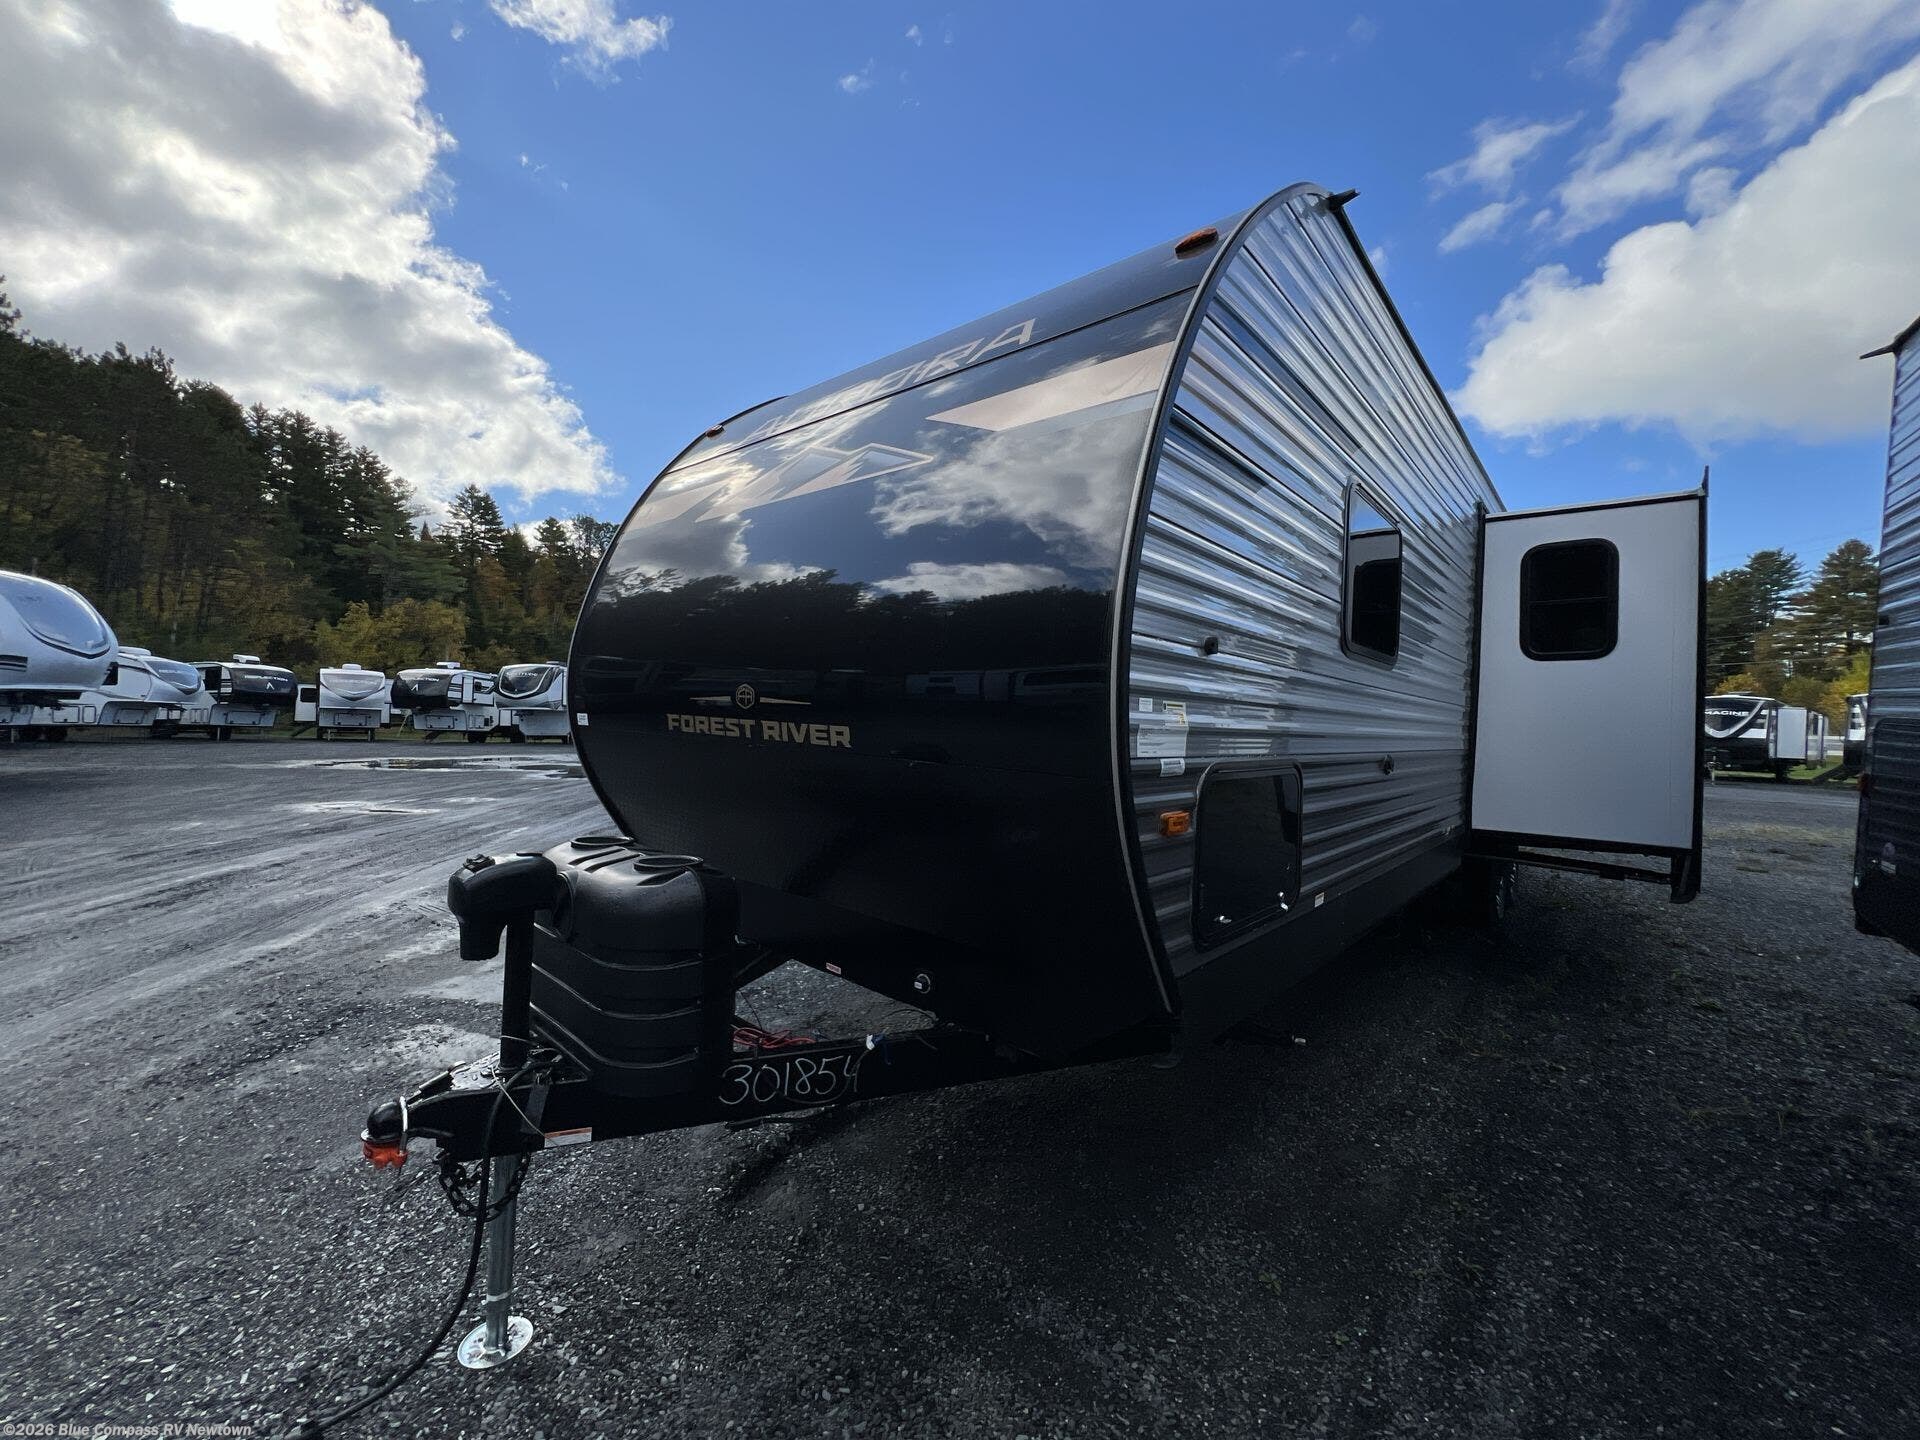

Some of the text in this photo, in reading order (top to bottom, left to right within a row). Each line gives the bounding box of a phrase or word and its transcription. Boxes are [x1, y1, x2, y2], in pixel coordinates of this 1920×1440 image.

[667, 713, 852, 748] FOREST RIVER
[719, 1055, 861, 1105] 301854
